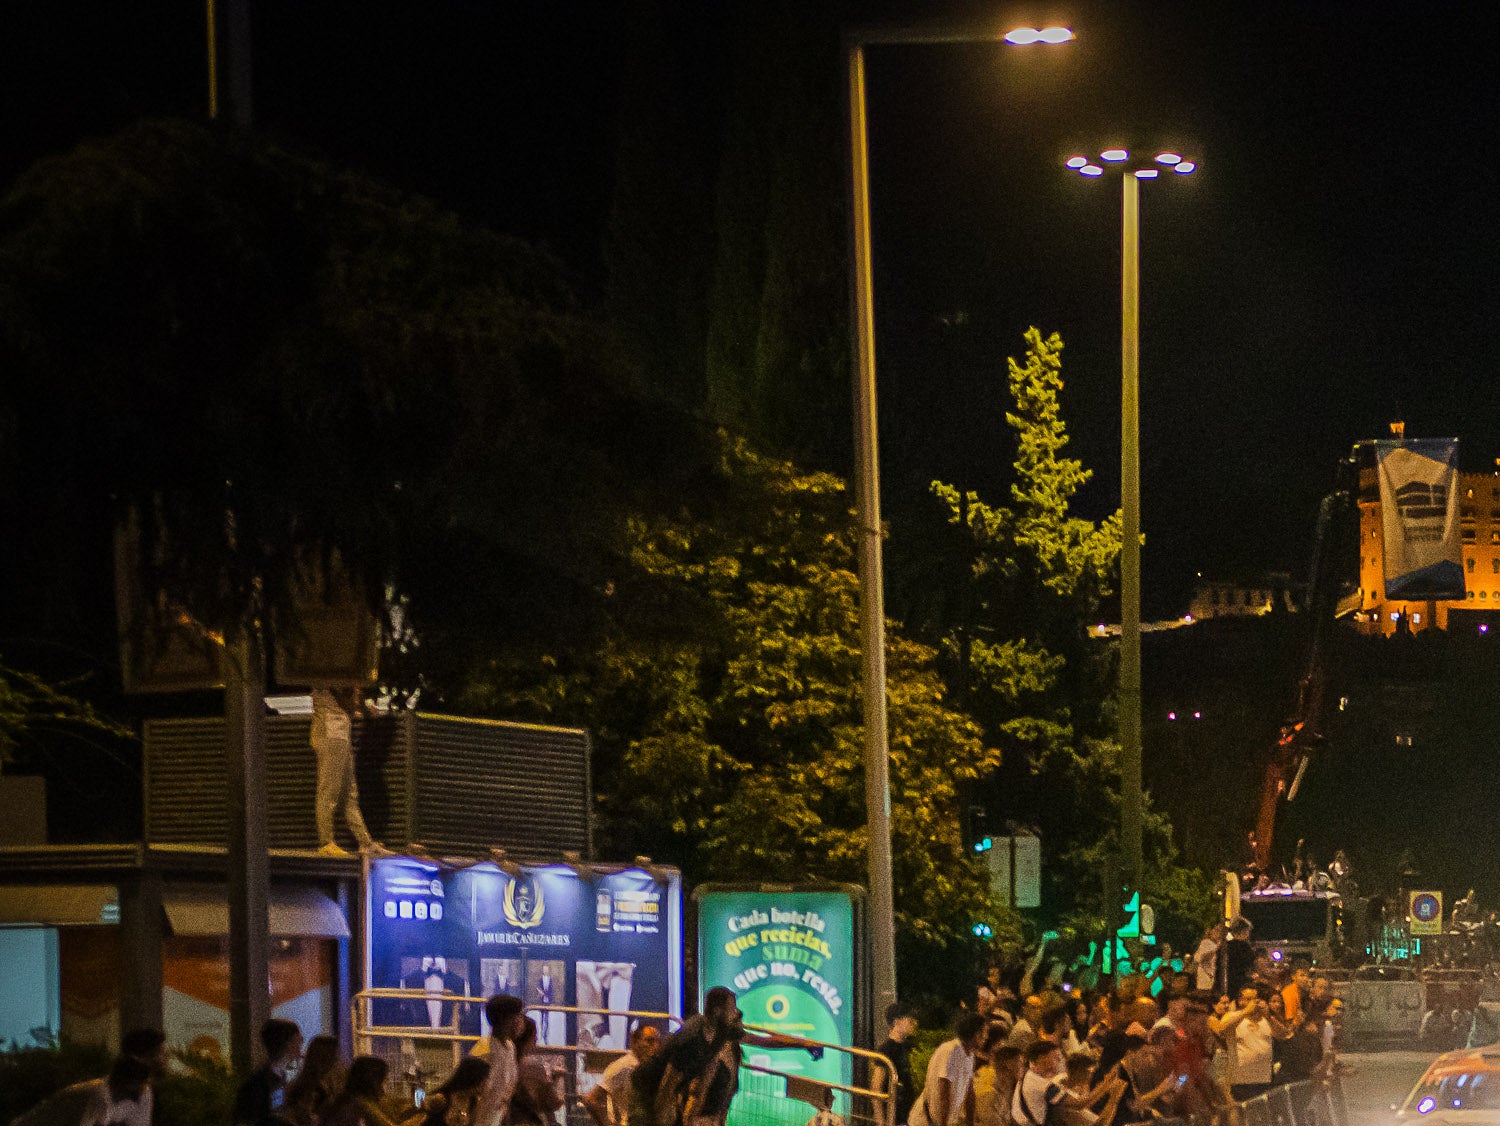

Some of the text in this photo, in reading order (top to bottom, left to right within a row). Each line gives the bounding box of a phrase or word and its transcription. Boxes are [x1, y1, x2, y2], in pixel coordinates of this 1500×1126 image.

[728, 906, 826, 933] Cada botella
[724, 926, 832, 959] que reciclas,
[761, 944, 824, 972] suma
[733, 963, 769, 990] que
